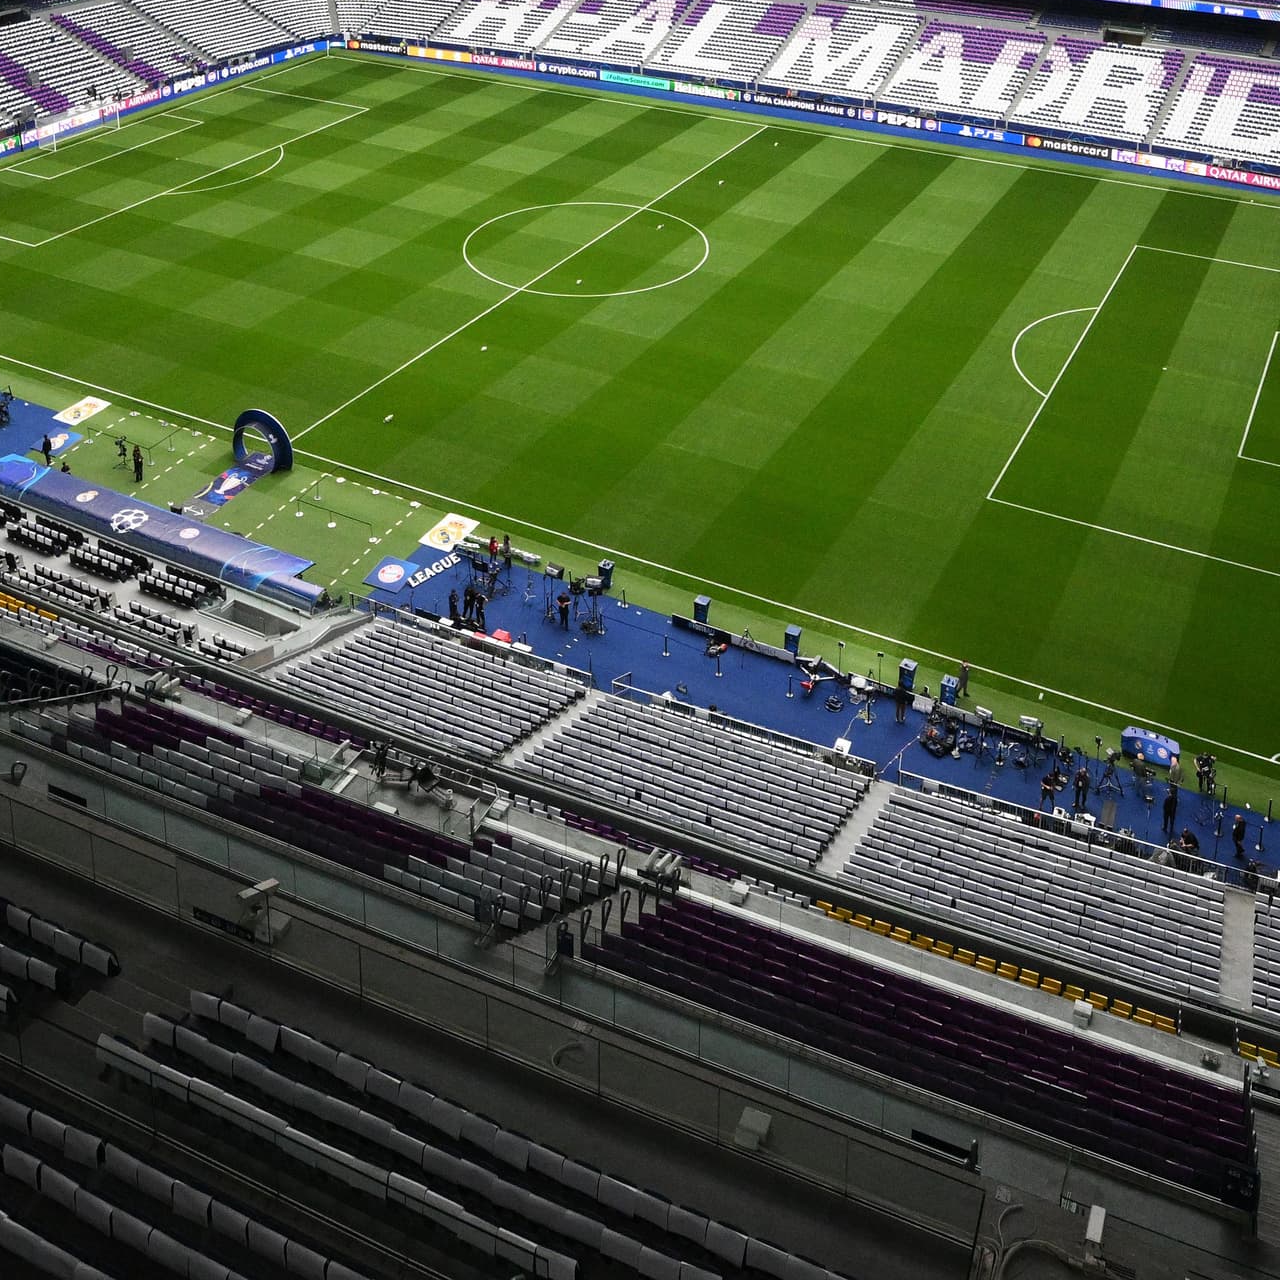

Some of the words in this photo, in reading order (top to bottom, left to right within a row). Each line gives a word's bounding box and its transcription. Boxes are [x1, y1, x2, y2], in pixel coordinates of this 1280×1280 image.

[360, 42, 406, 54] mastercar
[230, 58, 269, 75] crypto.com
[473, 55, 498, 65] QATAR
[502, 58, 534, 70] AIRWAYS
[548, 64, 597, 78] crypto.com
[173, 74, 206, 93] PEPSI
[674, 82, 725, 98] Heineken
[128, 90, 159, 106] AIRWAYS
[754, 94, 772, 104] UEFA
[774, 97, 815, 111] CHAMPIONS
[816, 104, 844, 115] LEAGUE
[877, 112, 920, 128] PEPSI
[975, 127, 1004, 141] PS5
[1043, 139, 1108, 158] mastercard
[1116, 149, 1151, 165] FedEx
[1165, 157, 1200, 174] FedEx
[1209, 168, 1247, 182] QATAR
[407, 552, 461, 588] LEAGUE
